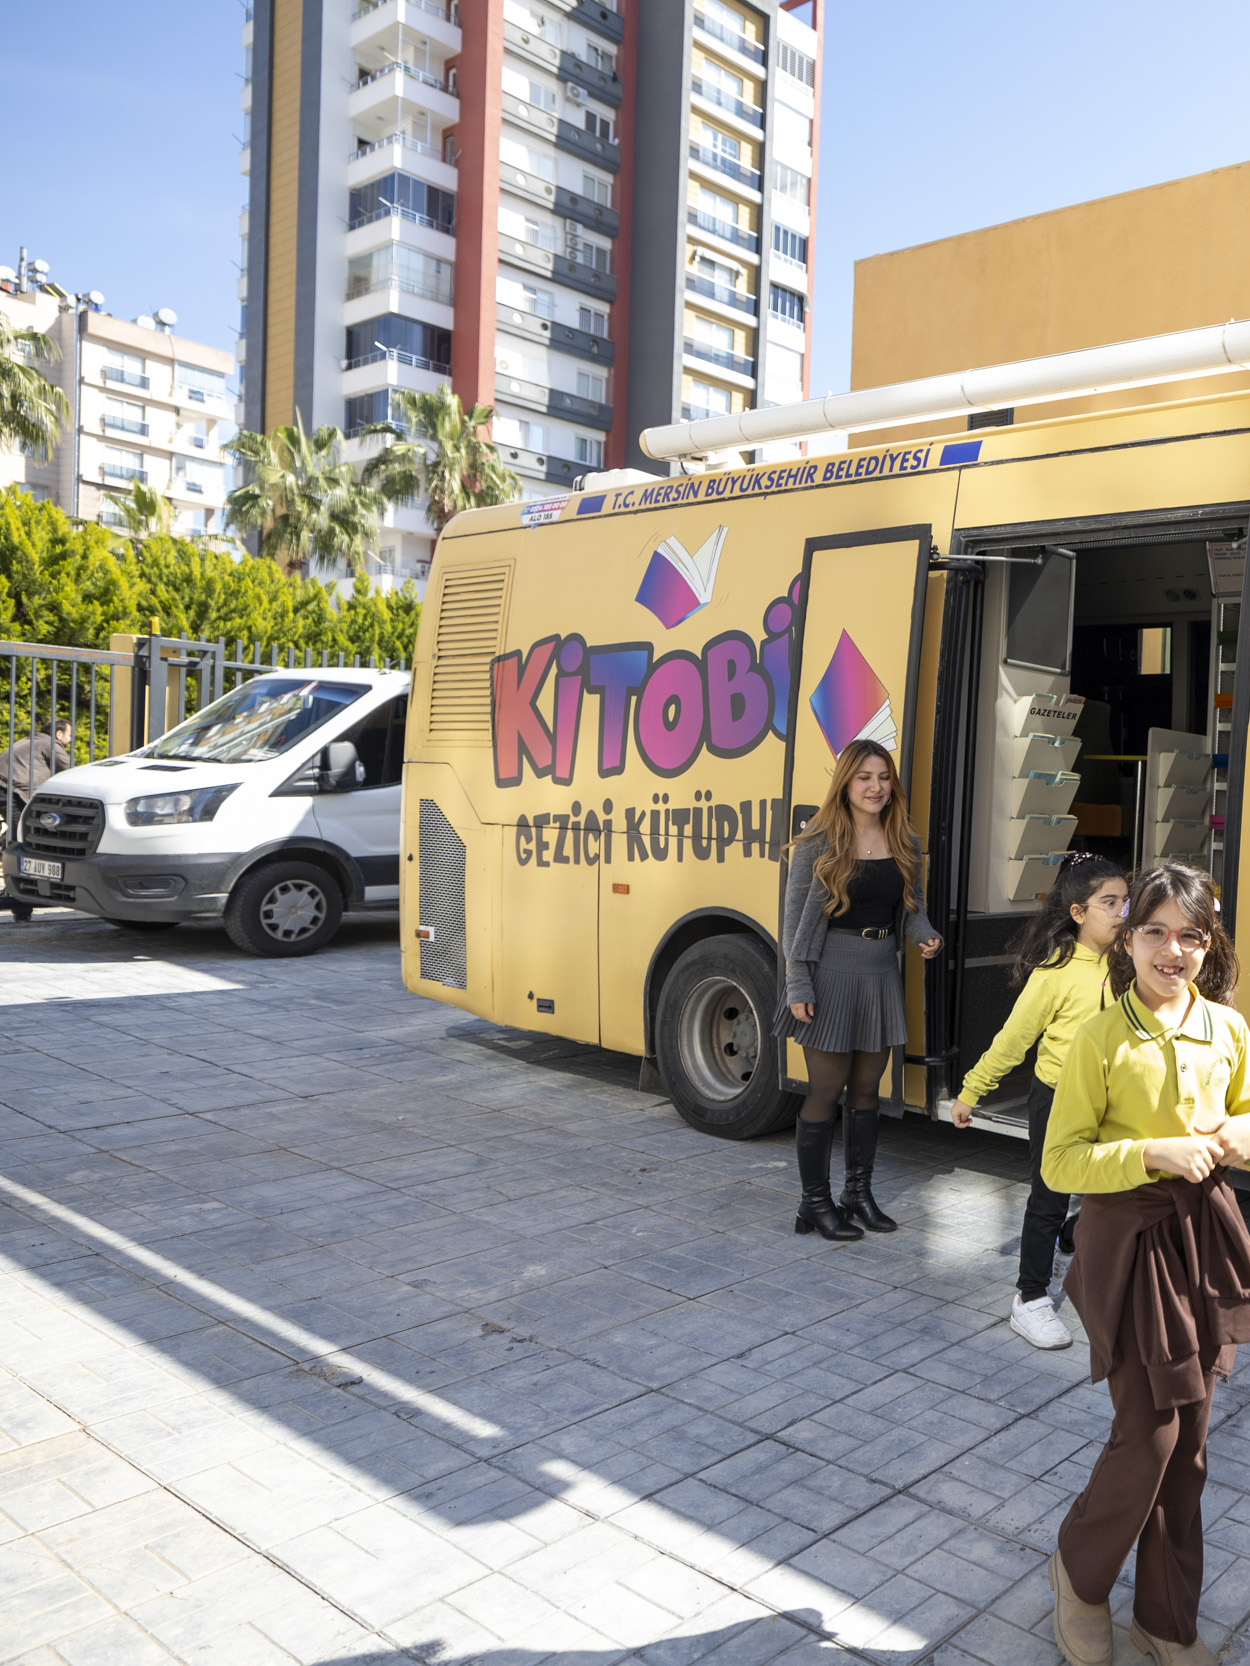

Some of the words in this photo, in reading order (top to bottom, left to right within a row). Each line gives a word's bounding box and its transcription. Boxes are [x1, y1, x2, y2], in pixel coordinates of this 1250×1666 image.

[612, 490, 635, 510] T.C.
[638, 477, 701, 506] MERSİN
[704, 461, 817, 500] BÜYÜKŞEHİR
[823, 442, 935, 478] BELEDİYESİ
[529, 514, 542, 522] ALO
[1030, 707, 1077, 720] GAZETELER
